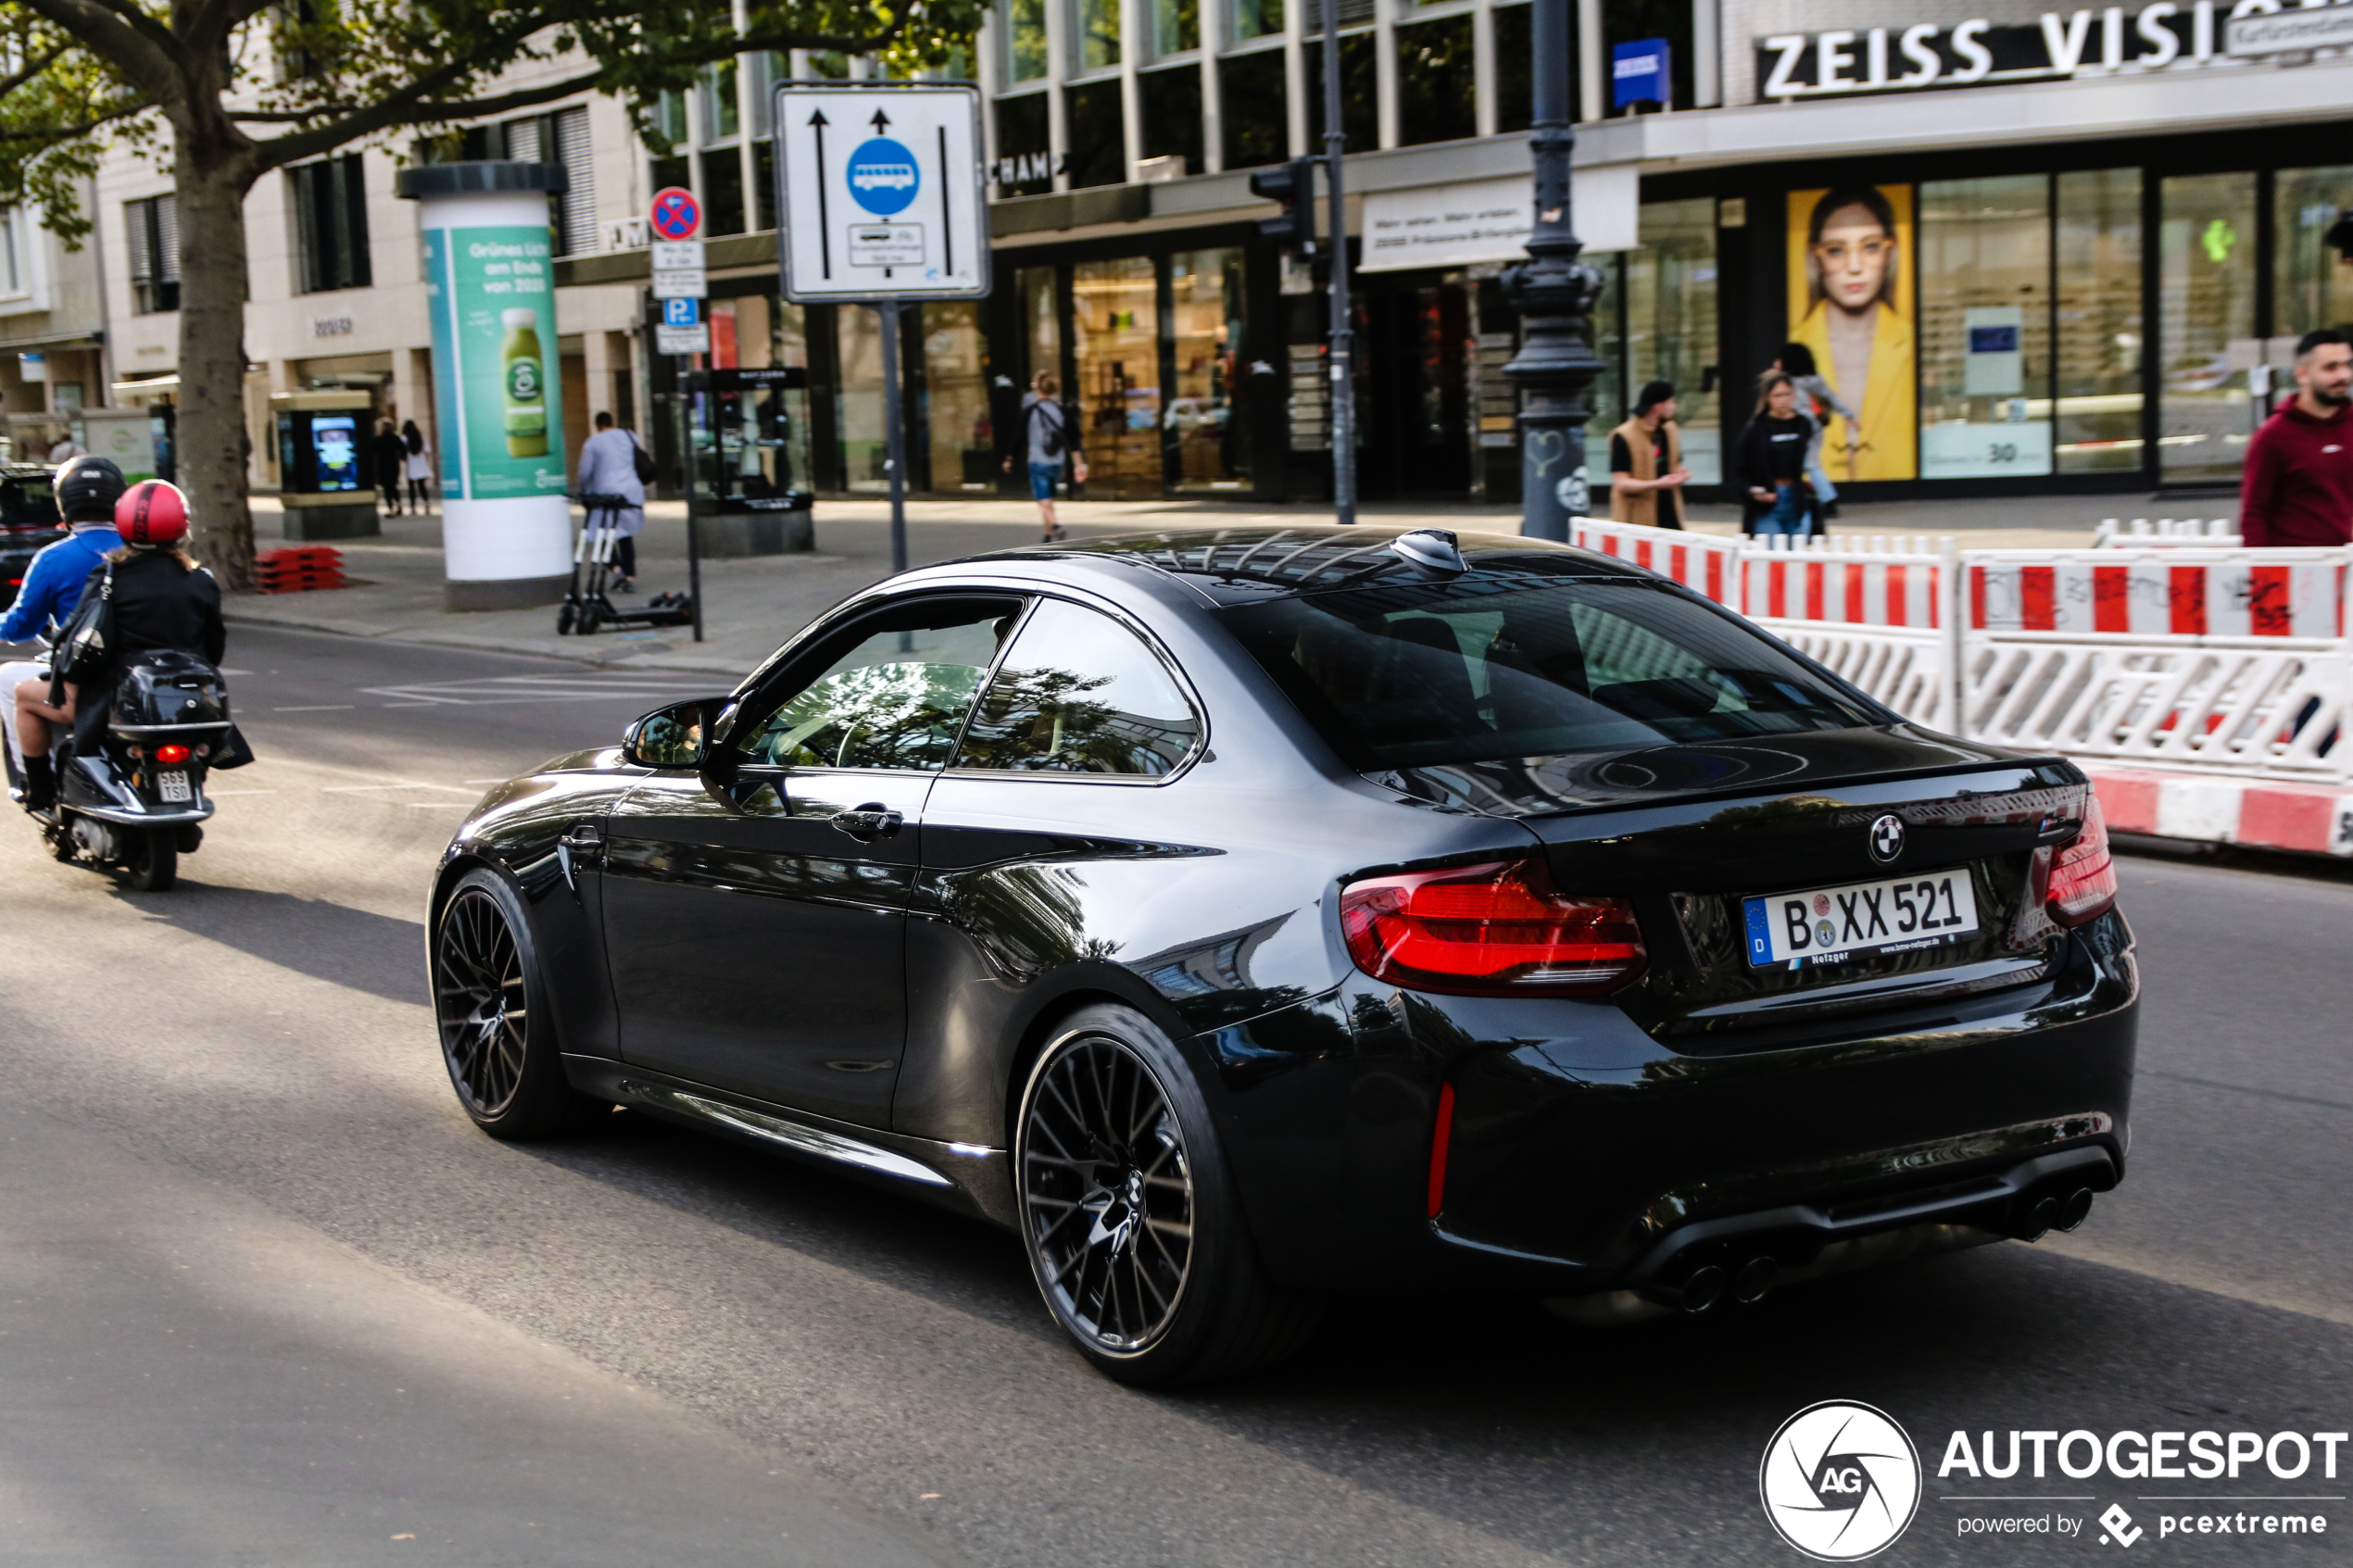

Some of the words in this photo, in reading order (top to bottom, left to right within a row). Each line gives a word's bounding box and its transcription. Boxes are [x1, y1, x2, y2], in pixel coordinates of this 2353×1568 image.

[1764, 18, 1994, 96] ZEISS
[469, 242, 522, 258] Grünes
[1989, 443, 2018, 463] 30
[1784, 900, 1812, 950] B
[1837, 887, 1890, 943] XX
[1894, 877, 1963, 933] 521
[1755, 938, 1765, 953] D
[1811, 951, 1849, 964] Nefzger
